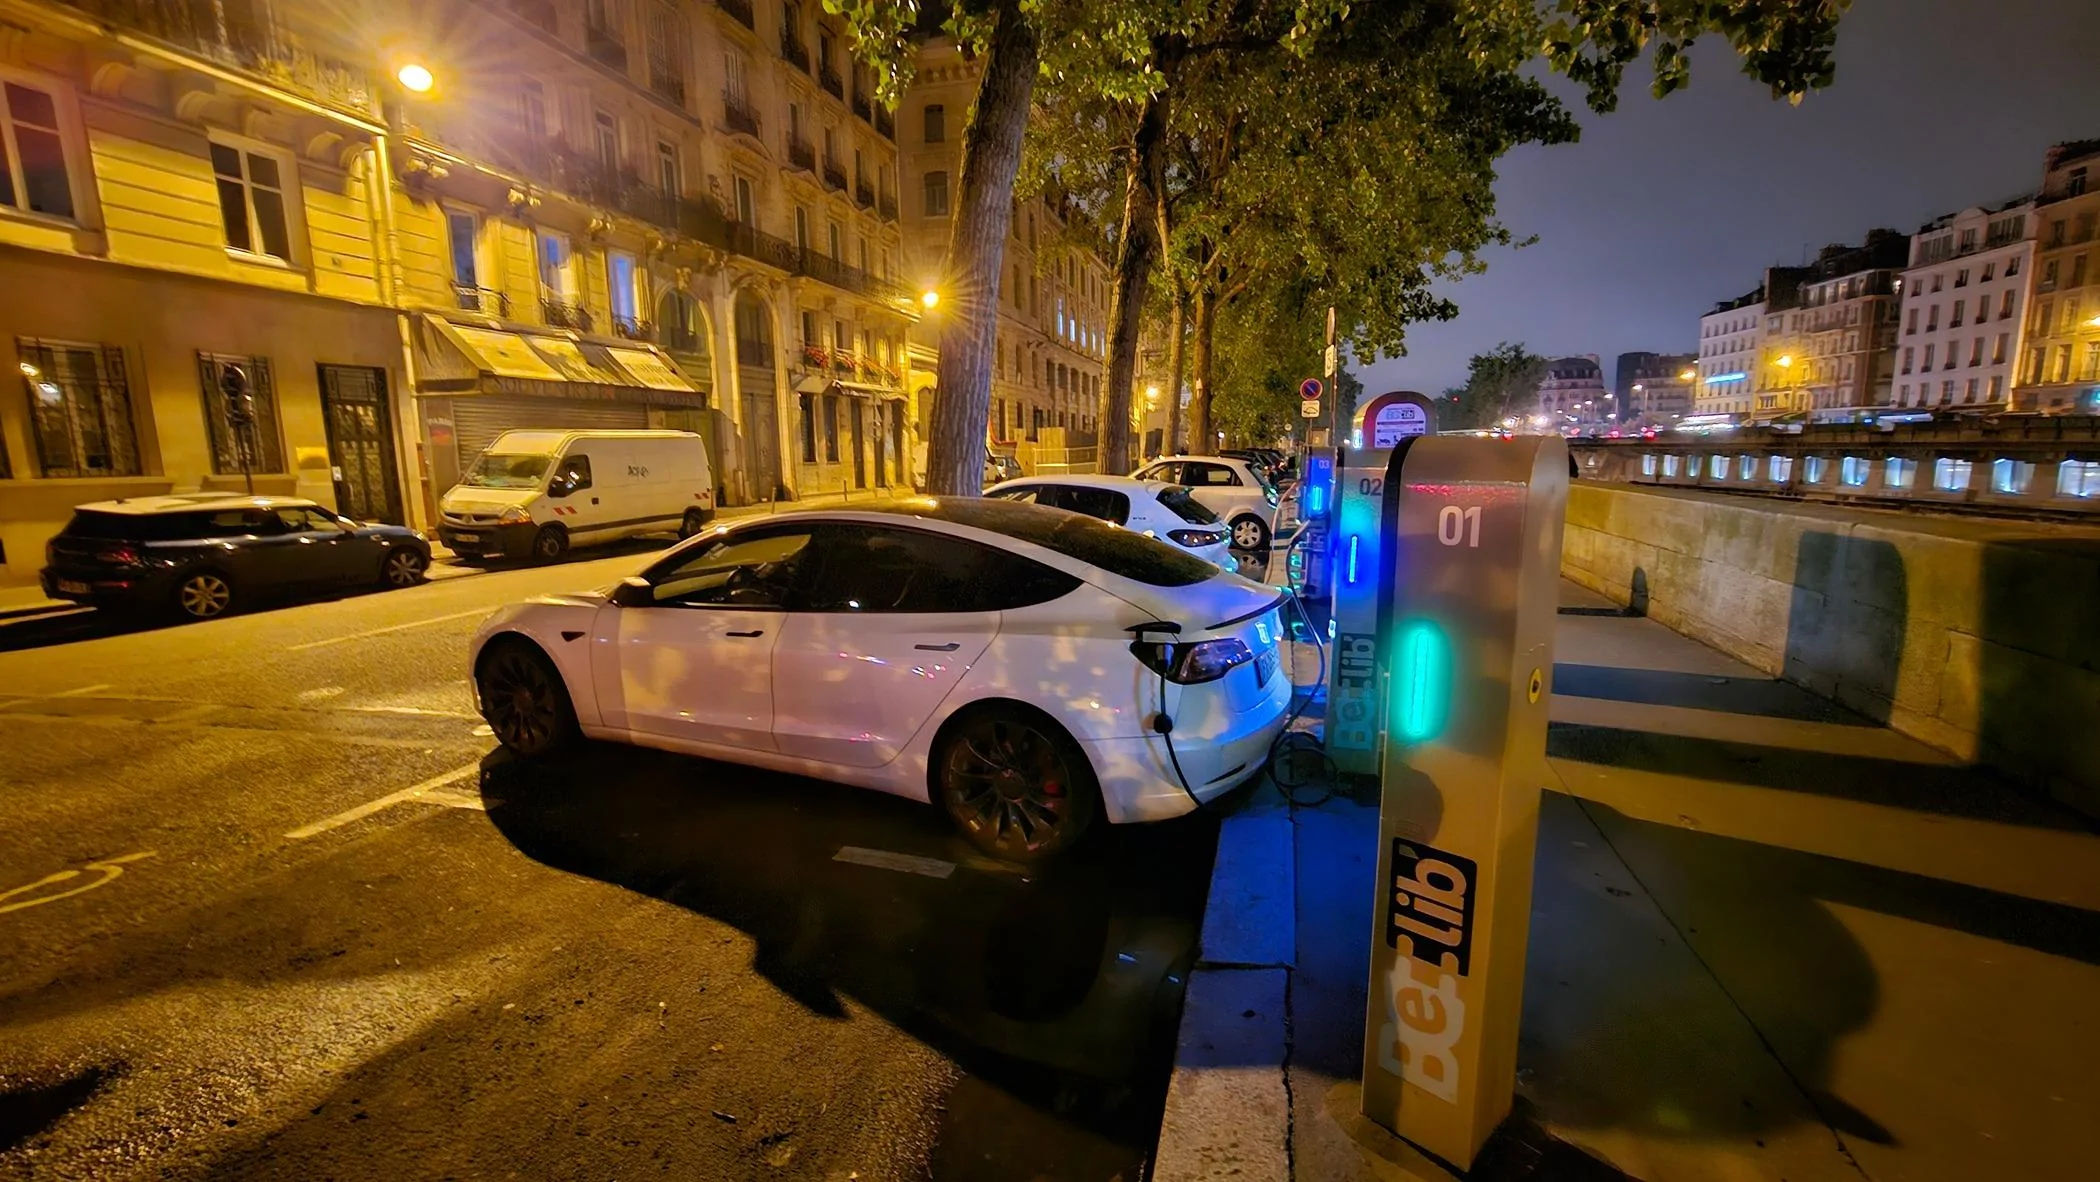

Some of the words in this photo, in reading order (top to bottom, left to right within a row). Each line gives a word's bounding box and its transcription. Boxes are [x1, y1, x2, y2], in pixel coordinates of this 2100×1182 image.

[1318, 459, 1330, 470] 03
[1359, 478, 1382, 497] 02
[1438, 505, 1481, 548] 01
